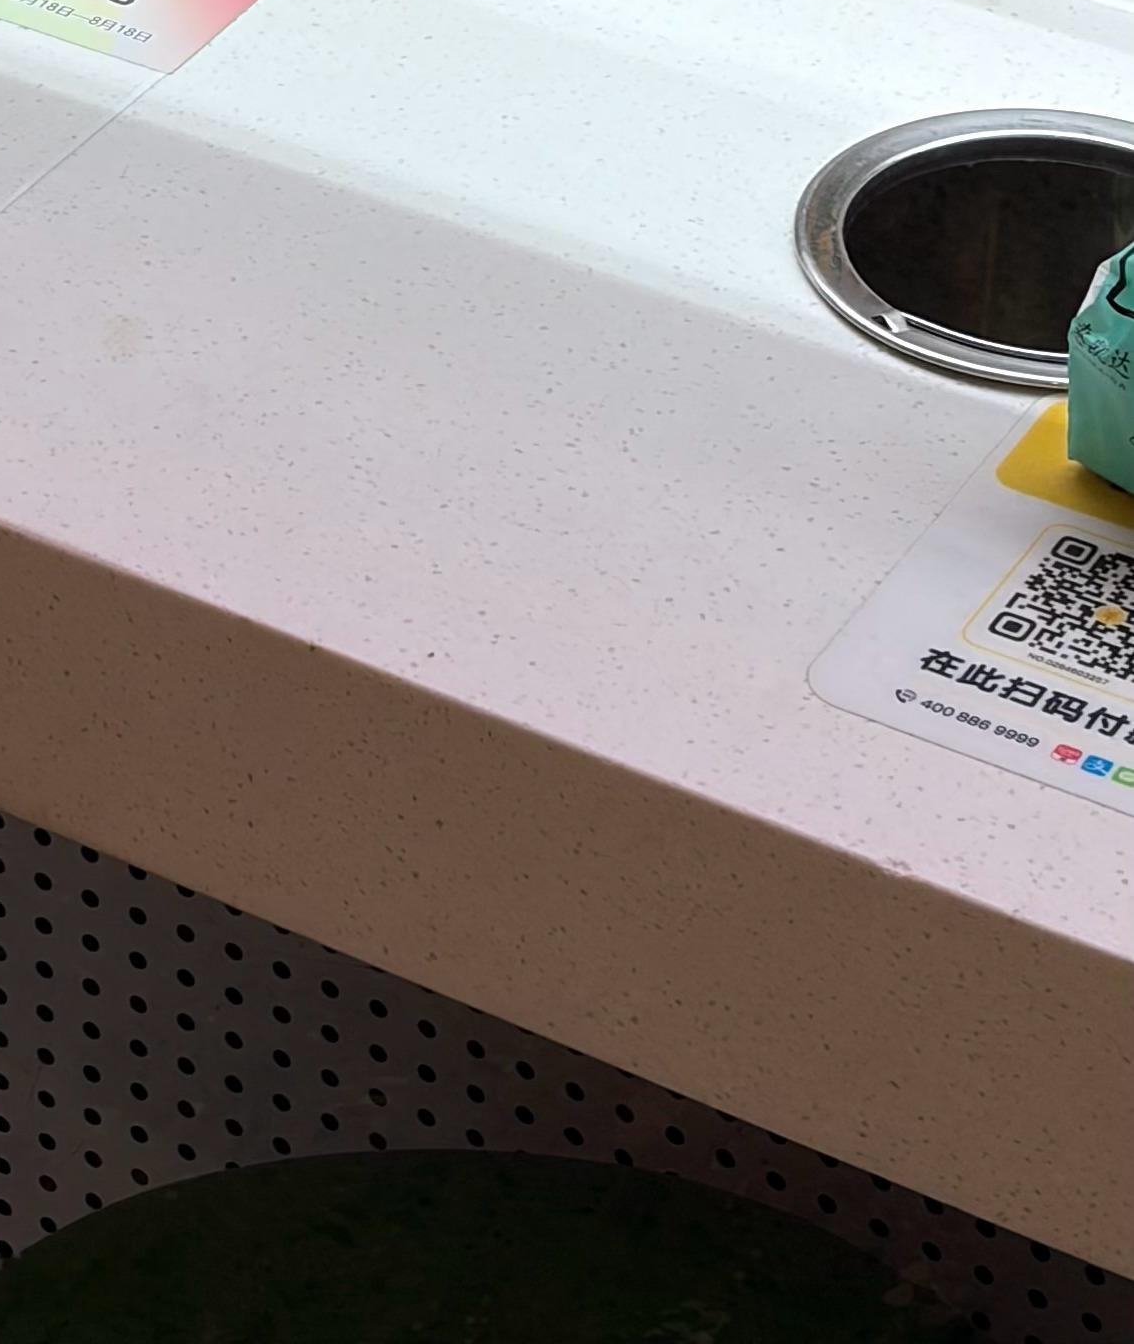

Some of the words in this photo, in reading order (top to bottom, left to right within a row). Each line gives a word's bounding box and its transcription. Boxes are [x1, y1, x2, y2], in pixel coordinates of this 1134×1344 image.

[920, 648, 1134, 745] 在此扫码付
[921, 699, 956, 717] 400
[956, 711, 993, 731] 886
[993, 725, 1041, 748] 9999
